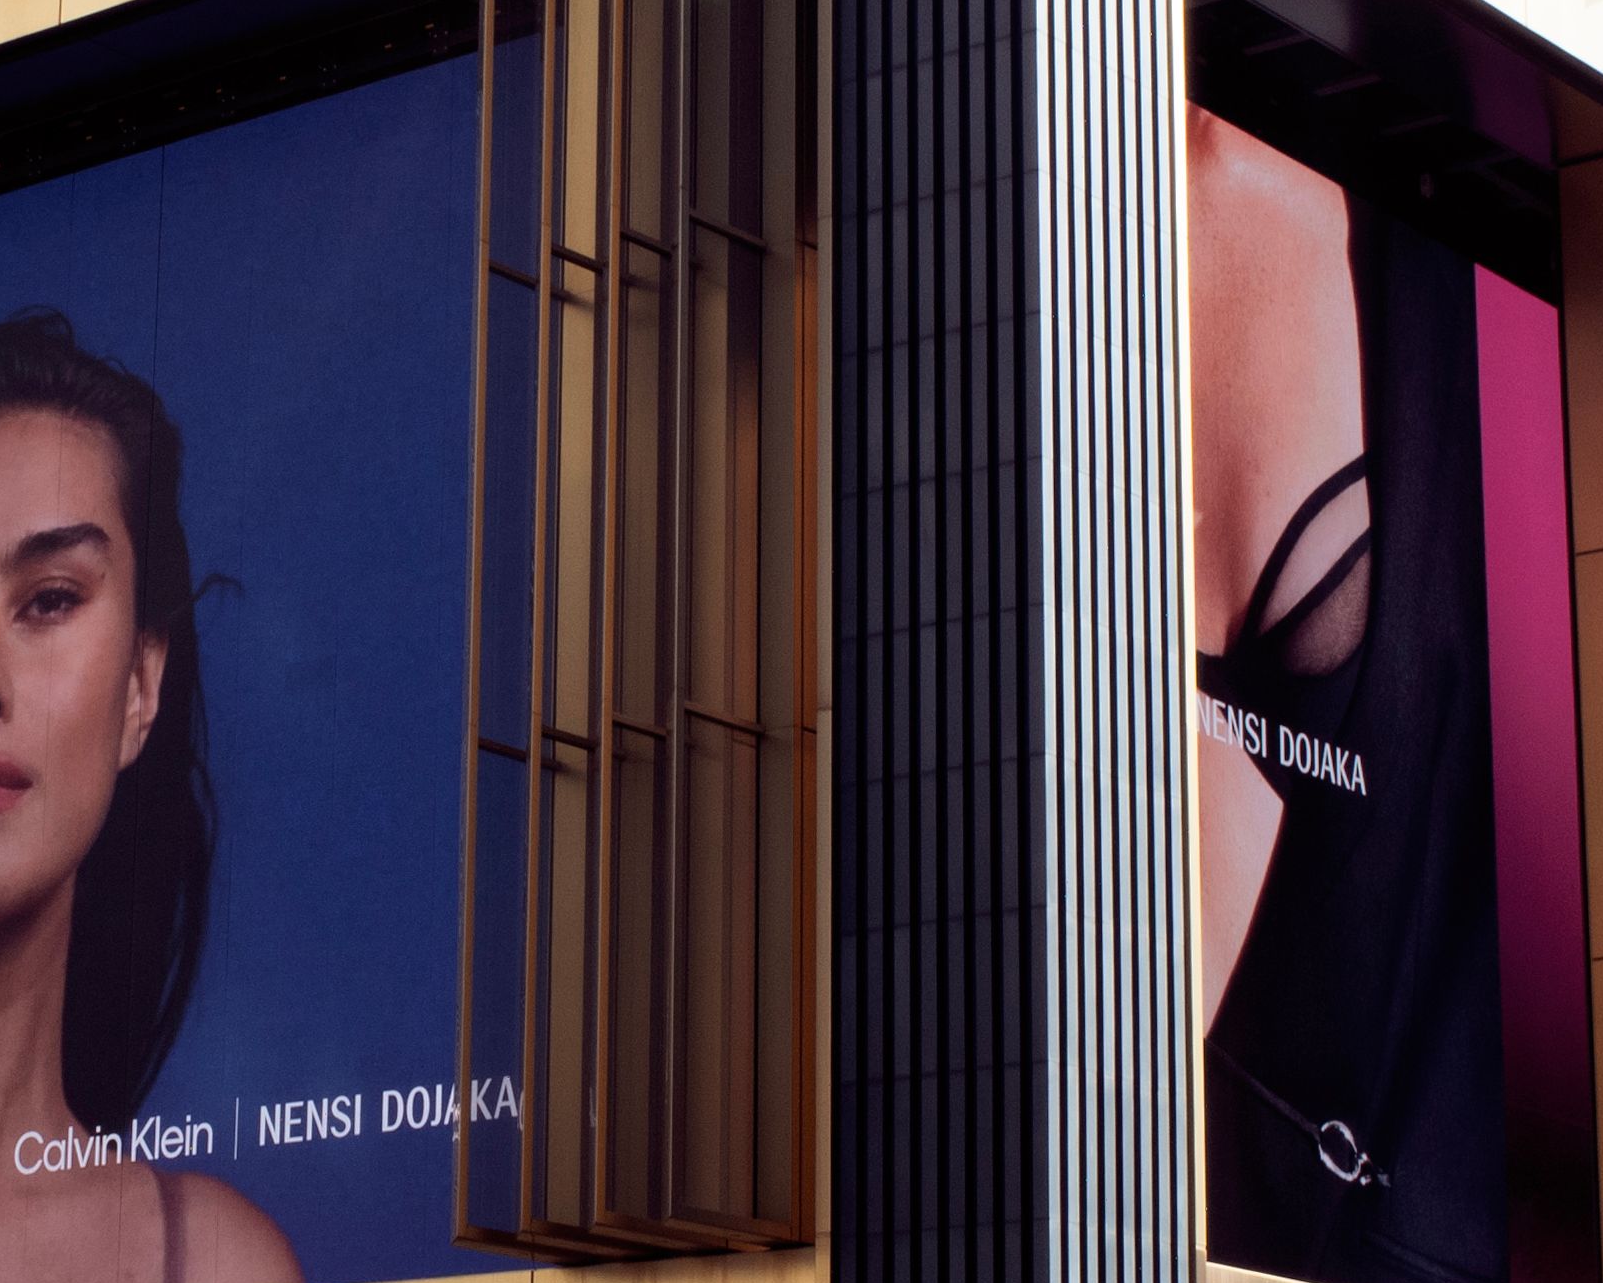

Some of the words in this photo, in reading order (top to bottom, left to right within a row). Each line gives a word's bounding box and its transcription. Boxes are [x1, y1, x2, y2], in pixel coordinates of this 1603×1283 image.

[1196, 694, 1267, 759] NENSI
[1279, 724, 1367, 797] DOJAKA
[14, 1125, 122, 1176] Calvin
[131, 1114, 213, 1163] Klein
[259, 1094, 362, 1147] NENSI
